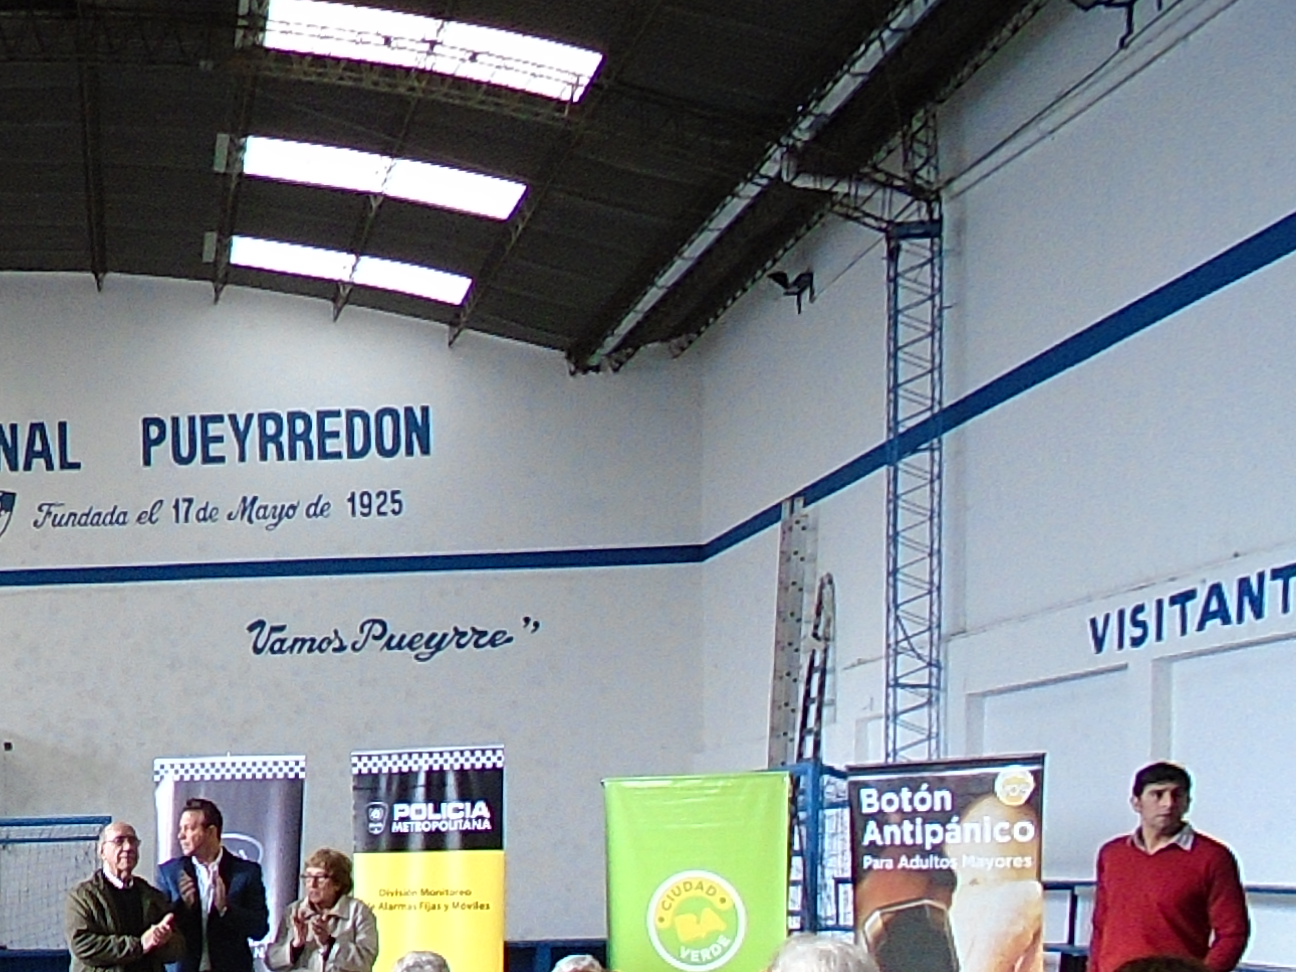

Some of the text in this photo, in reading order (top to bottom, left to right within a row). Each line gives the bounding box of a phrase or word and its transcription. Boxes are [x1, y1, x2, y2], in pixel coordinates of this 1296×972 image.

[141, 405, 430, 467] PUEYRREDON
[33, 489, 403, 531] Fundada el 17 de Mayo de 1925
[246, 619, 347, 655] Vamos
[393, 801, 491, 821] POLICIA
[860, 783, 952, 814] Botón
[391, 819, 492, 833] METROPOLITANA
[862, 816, 1035, 850] Antipánico
[863, 853, 1032, 870] Para Adultos Mayores
[419, 902, 441, 912] Fijas
[661, 881, 718, 911] CIUDAD
[680, 935, 731, 962] VERDE
